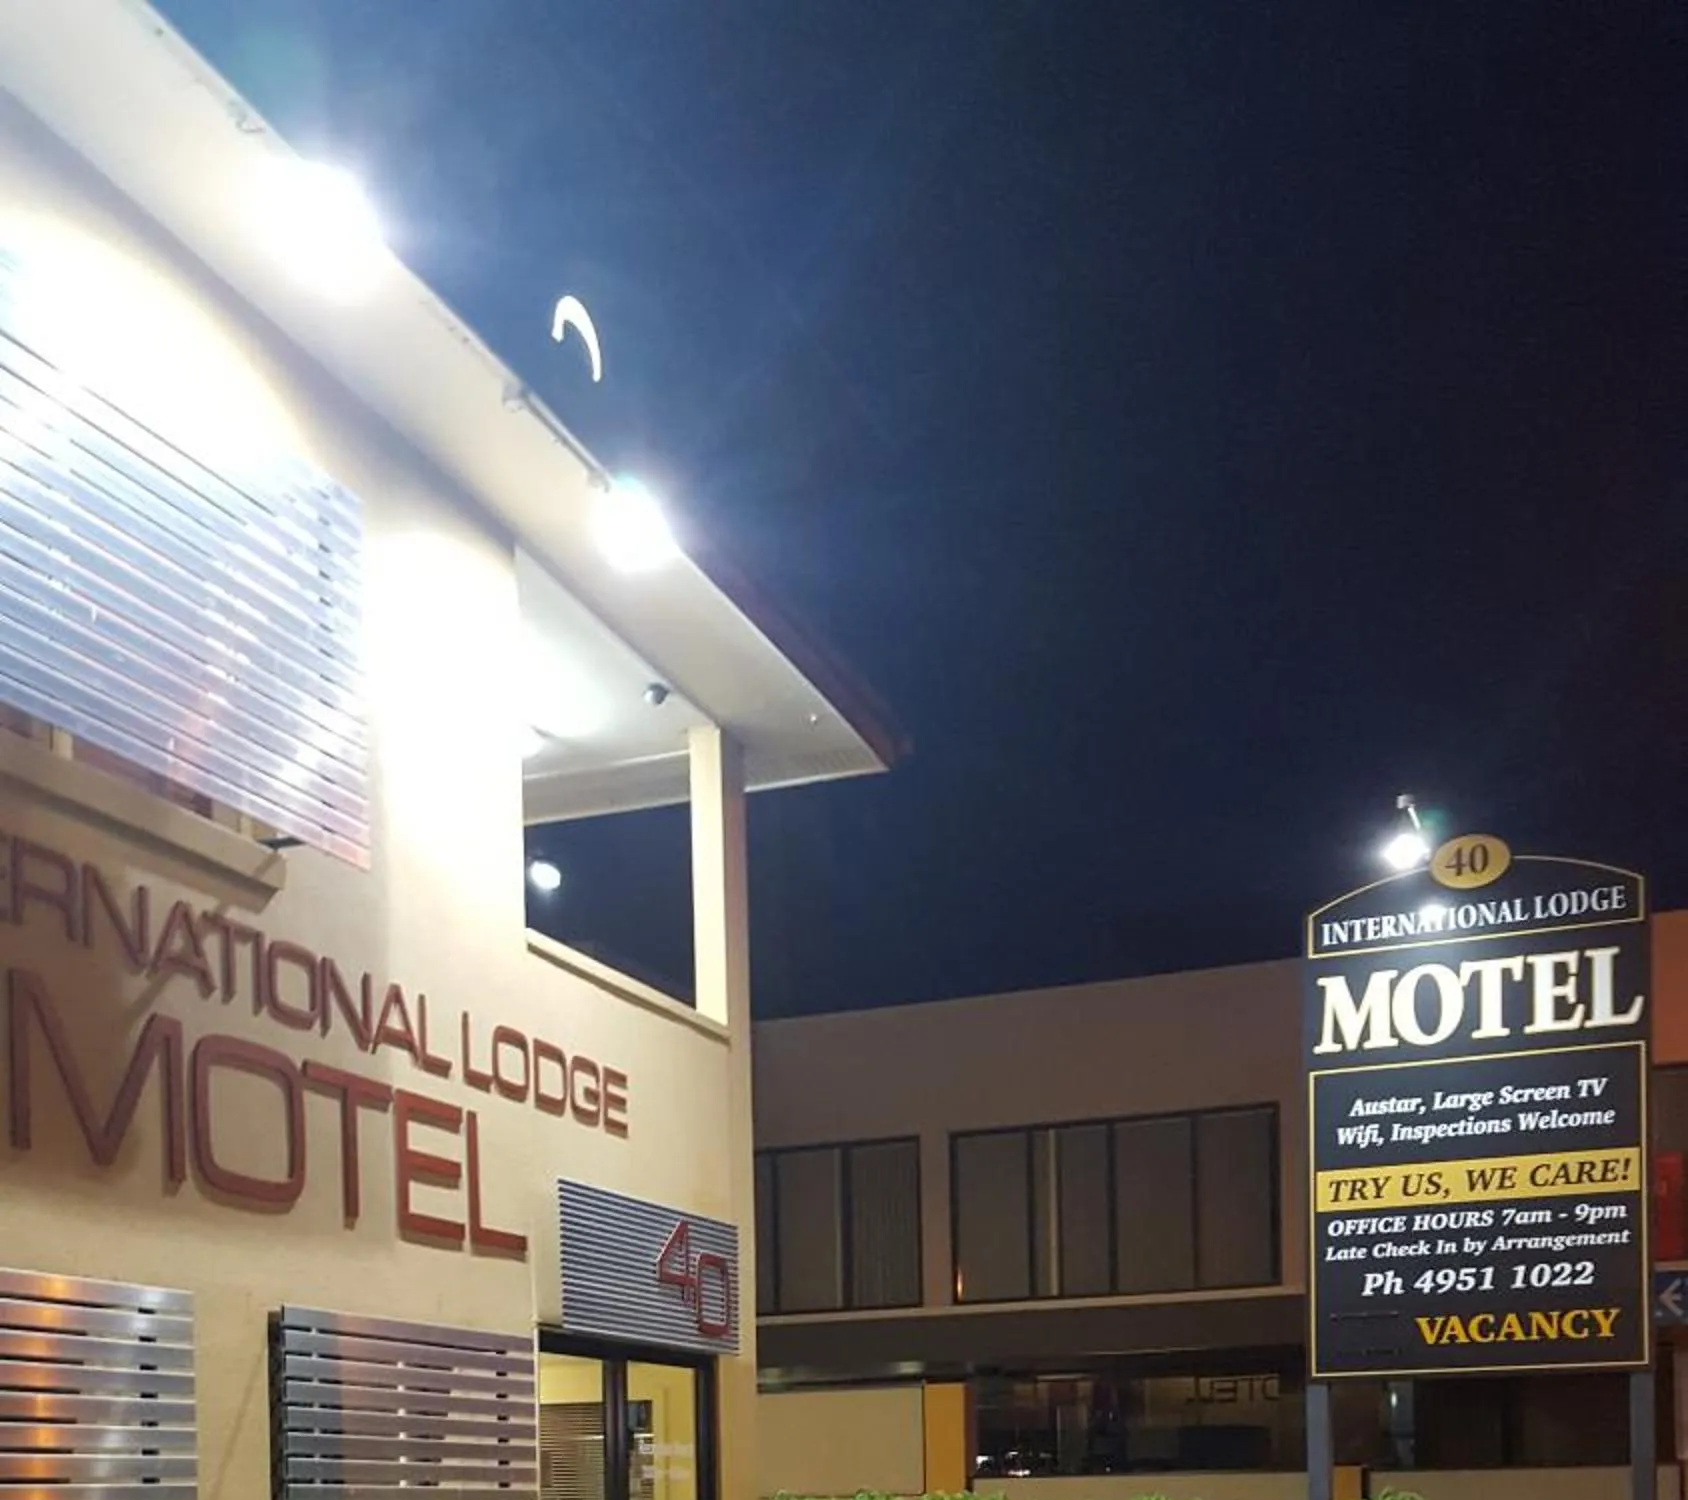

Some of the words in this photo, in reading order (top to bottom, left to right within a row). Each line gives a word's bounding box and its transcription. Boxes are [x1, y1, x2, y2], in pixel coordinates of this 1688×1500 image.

[1445, 843, 1489, 877] 40
[1321, 898, 1529, 946] INTERNATIONAL
[1534, 885, 1628, 919] LODGE
[0, 832, 451, 1077] RNATIONAL
[462, 1011, 628, 1138] LODGE
[1313, 947, 1645, 1055] MOTEL
[8, 968, 528, 1255] MOTEL
[1349, 1097, 1427, 1118] Austar,
[1432, 1089, 1494, 1114] Large
[1499, 1083, 1572, 1106] Screen
[1577, 1077, 1609, 1098] TV
[1337, 1124, 1385, 1149] Wifi,
[1390, 1113, 1512, 1145] Inspections
[1518, 1107, 1616, 1132] Welcome
[1328, 1176, 1391, 1203] TRY
[1401, 1171, 1451, 1199] US,
[1465, 1166, 1518, 1193] WE
[1529, 1157, 1632, 1187] CARE!
[1327, 1216, 1408, 1237] OFFICE
[1413, 1209, 1495, 1232] HOURS
[1501, 1207, 1552, 1227] 7am
[1574, 1203, 1628, 1226] 9pm
[1325, 1245, 1367, 1262] Late
[1372, 1239, 1431, 1259] Check
[1436, 1239, 1458, 1256] In
[1463, 1236, 1488, 1257] by
[1491, 1228, 1631, 1253] Arrangement
[655, 1219, 732, 1339] 40
[1361, 1272, 1405, 1297] Ph
[1413, 1266, 1496, 1294] 4951
[1510, 1260, 1596, 1290] 1022
[1415, 1307, 1622, 1346] VACANCY
